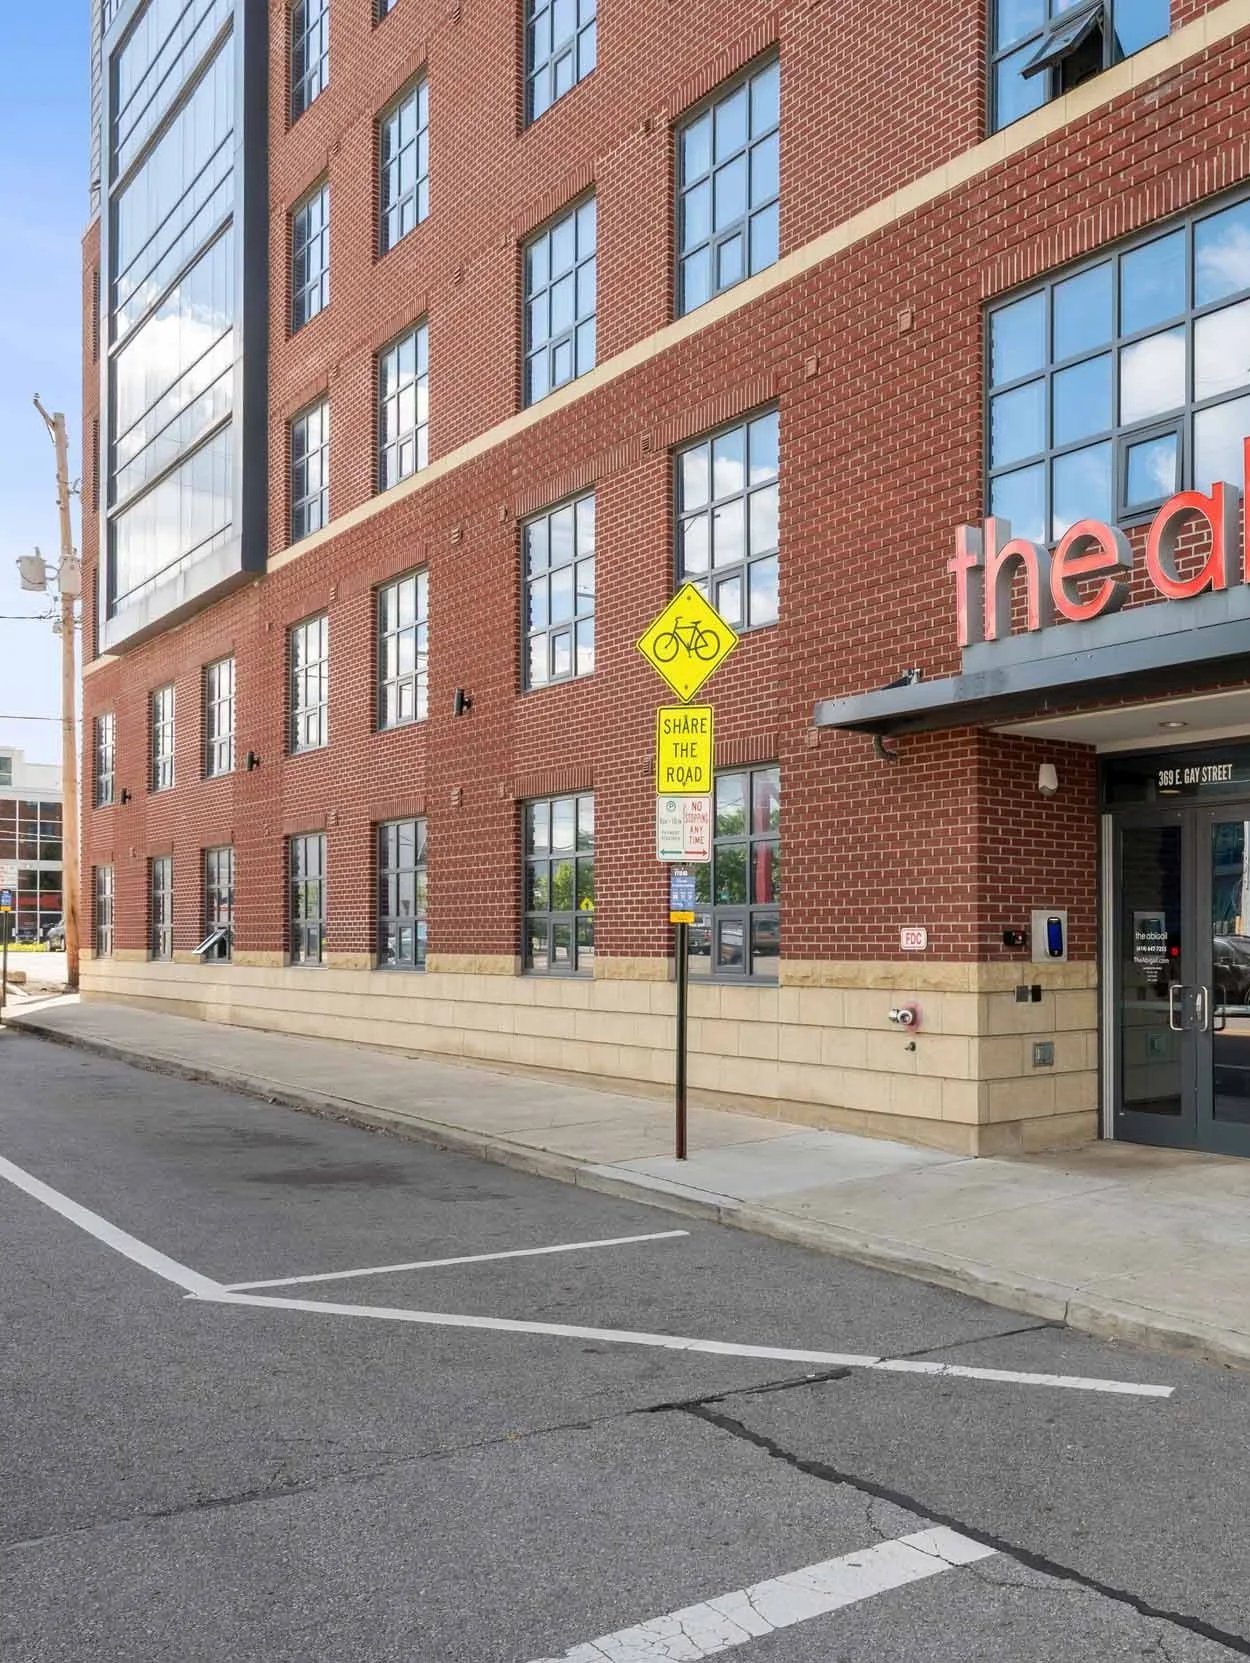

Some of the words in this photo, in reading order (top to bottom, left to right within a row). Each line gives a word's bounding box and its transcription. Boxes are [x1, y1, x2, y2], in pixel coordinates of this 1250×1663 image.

[947, 516, 1133, 648] the
[663, 715, 707, 735] SHARE
[672, 742, 697, 758] THE
[666, 766, 702, 783] ROAD
[1158, 769, 1174, 787] 369
[1175, 768, 1183, 785] E.
[1184, 767, 1200, 785] GAY
[1201, 764, 1233, 783] STREET
[691, 801, 703, 811] NO
[689, 835, 704, 845] TIME
[906, 932, 922, 945] FDC
